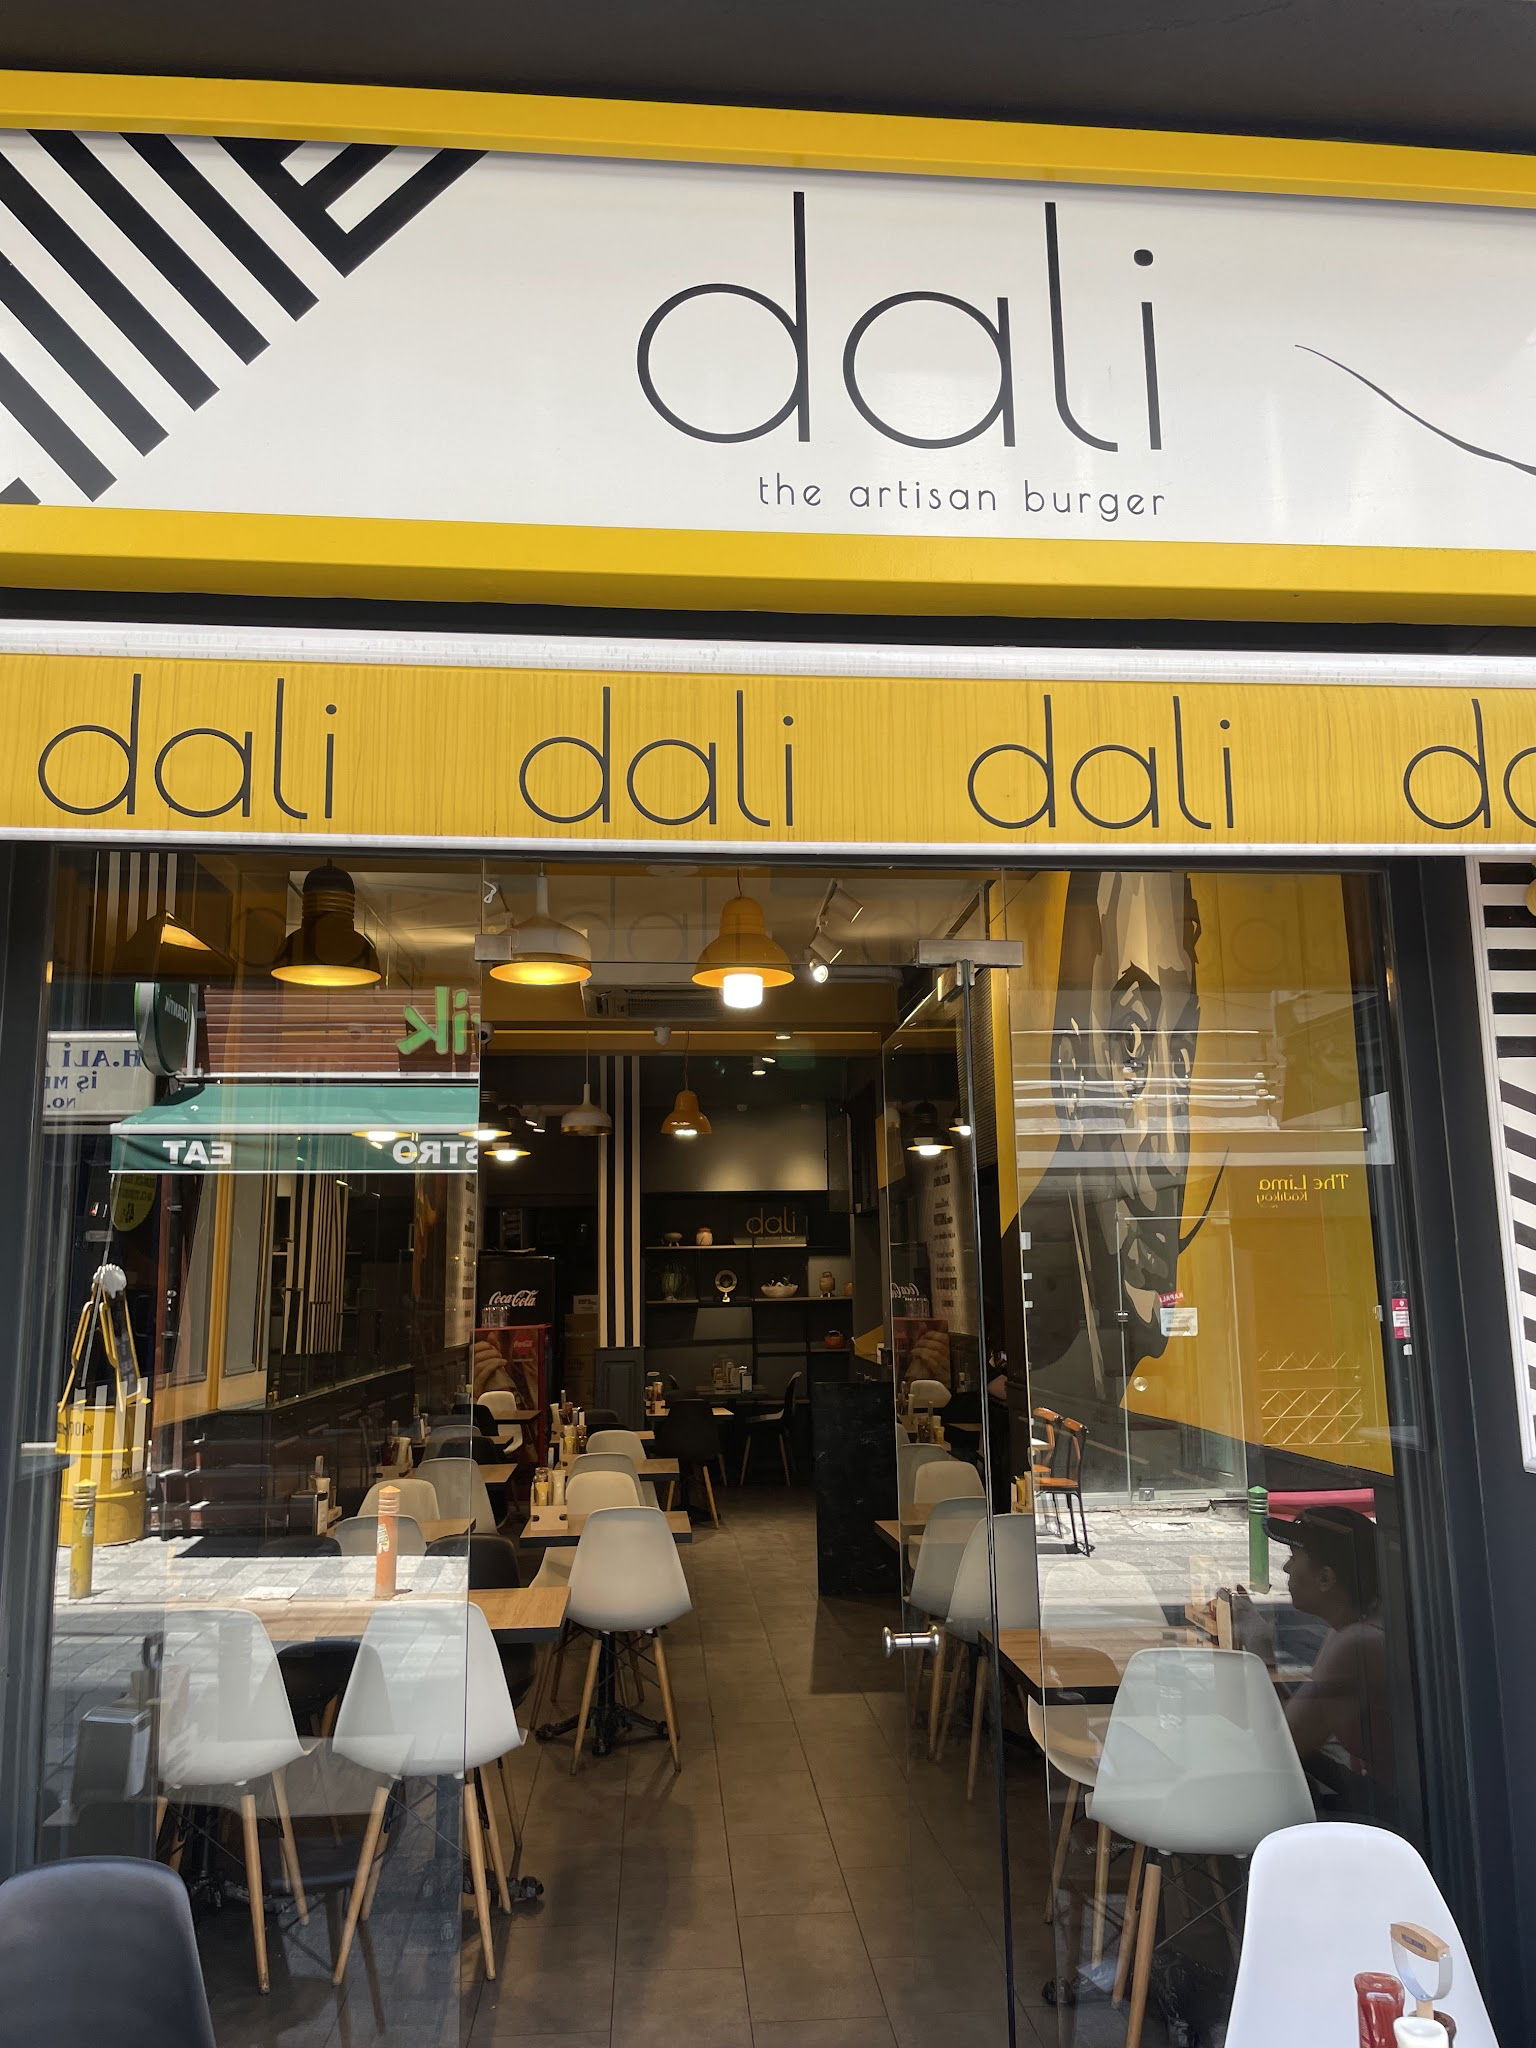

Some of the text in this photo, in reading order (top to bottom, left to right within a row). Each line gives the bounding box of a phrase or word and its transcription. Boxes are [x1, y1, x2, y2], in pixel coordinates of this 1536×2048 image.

[637, 191, 1162, 452] dali
[759, 473, 1166, 522] the artisan burger
[38, 673, 338, 820] dali
[519, 686, 794, 828] dali
[967, 694, 1234, 829] dali
[746, 1206, 796, 1234] dali
